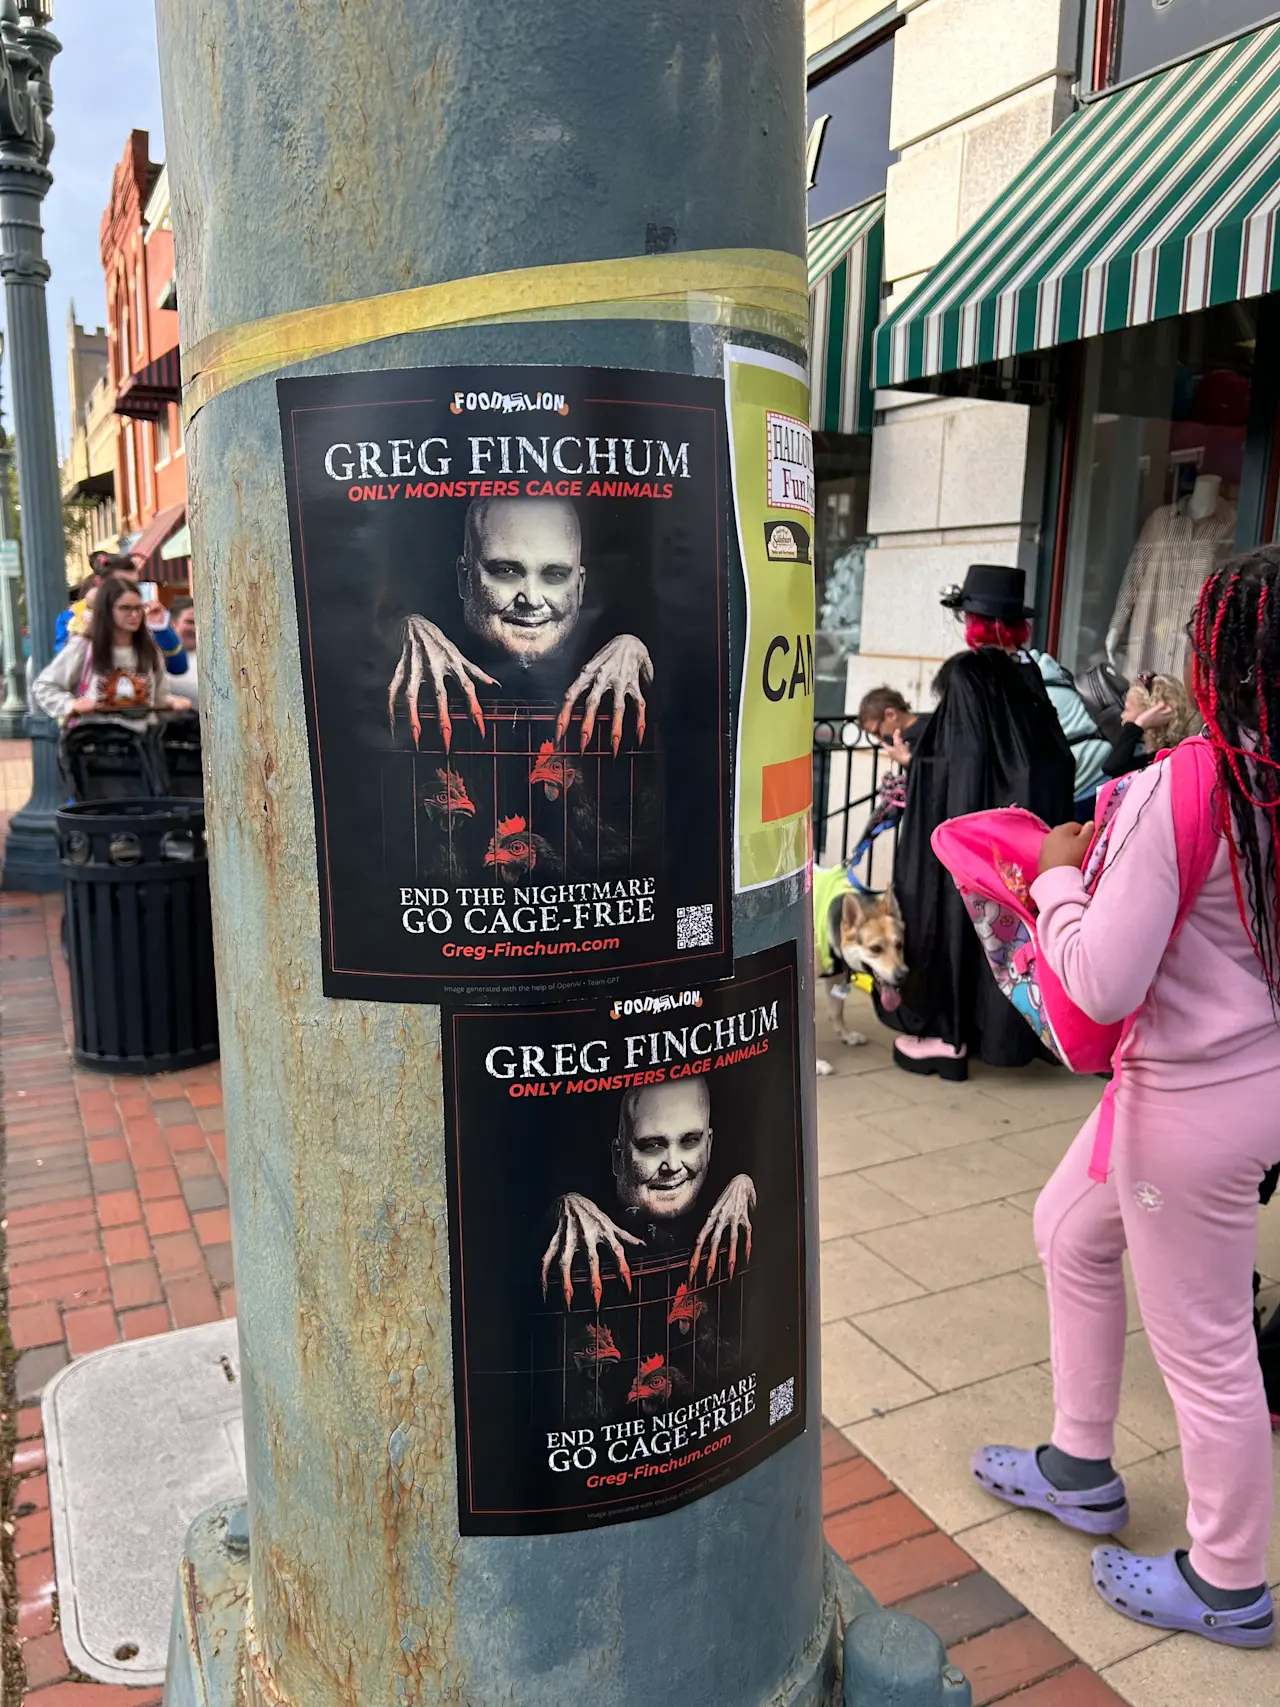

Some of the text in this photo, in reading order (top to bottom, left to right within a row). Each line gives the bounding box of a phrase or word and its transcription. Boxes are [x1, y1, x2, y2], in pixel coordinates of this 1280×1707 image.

[454, 391, 565, 411] FOOD LION
[324, 436, 691, 481] GREG FINCHUM
[349, 480, 674, 501] ONLY MONSTERS CAGE ANIMALS
[400, 877, 656, 906] END THE NIGHTMARE
[402, 898, 655, 934] GO CAGE-FREE
[442, 937, 620, 960] Greg-Finchum.com
[444, 985, 465, 993] Image
[466, 986, 500, 994] generated
[532, 984, 546, 992] help
[614, 990, 700, 1015] FOOD LION
[485, 1000, 779, 1079] GREG FINCHUM
[509, 1039, 769, 1098] ONLY MONSTERS CAGE ANIMALS
[547, 1373, 757, 1448] END THE NIGHTMARE
[548, 1390, 756, 1472] GO CAGE-FREE
[586, 1434, 732, 1488] Greg-Finchum.com
